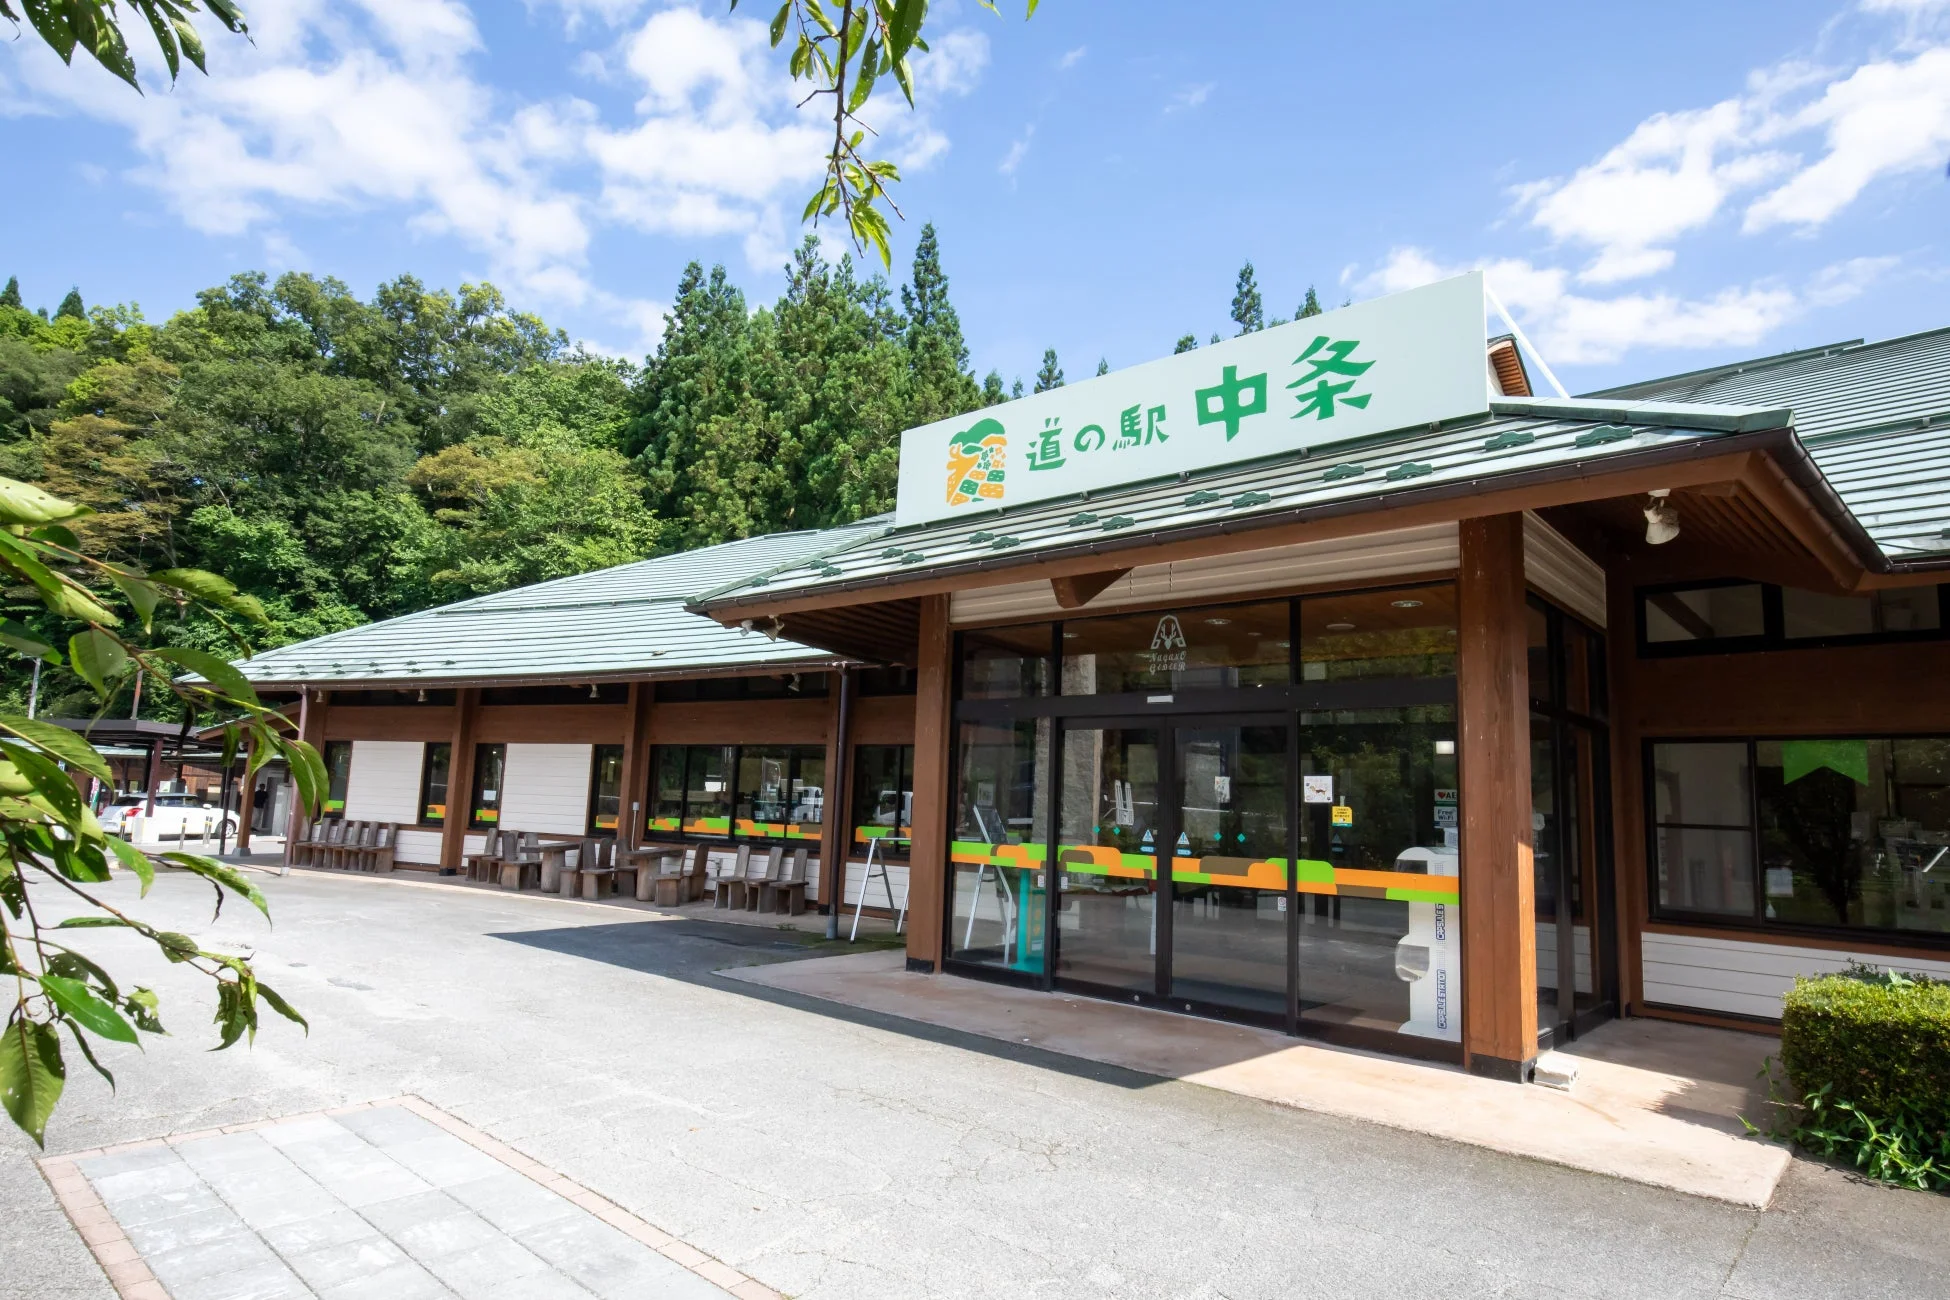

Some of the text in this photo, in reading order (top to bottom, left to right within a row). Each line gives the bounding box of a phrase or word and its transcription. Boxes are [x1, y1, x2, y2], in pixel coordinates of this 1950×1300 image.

[1026, 336, 1377, 471] 道の駅 中条
[1446, 791, 1457, 799] AE
